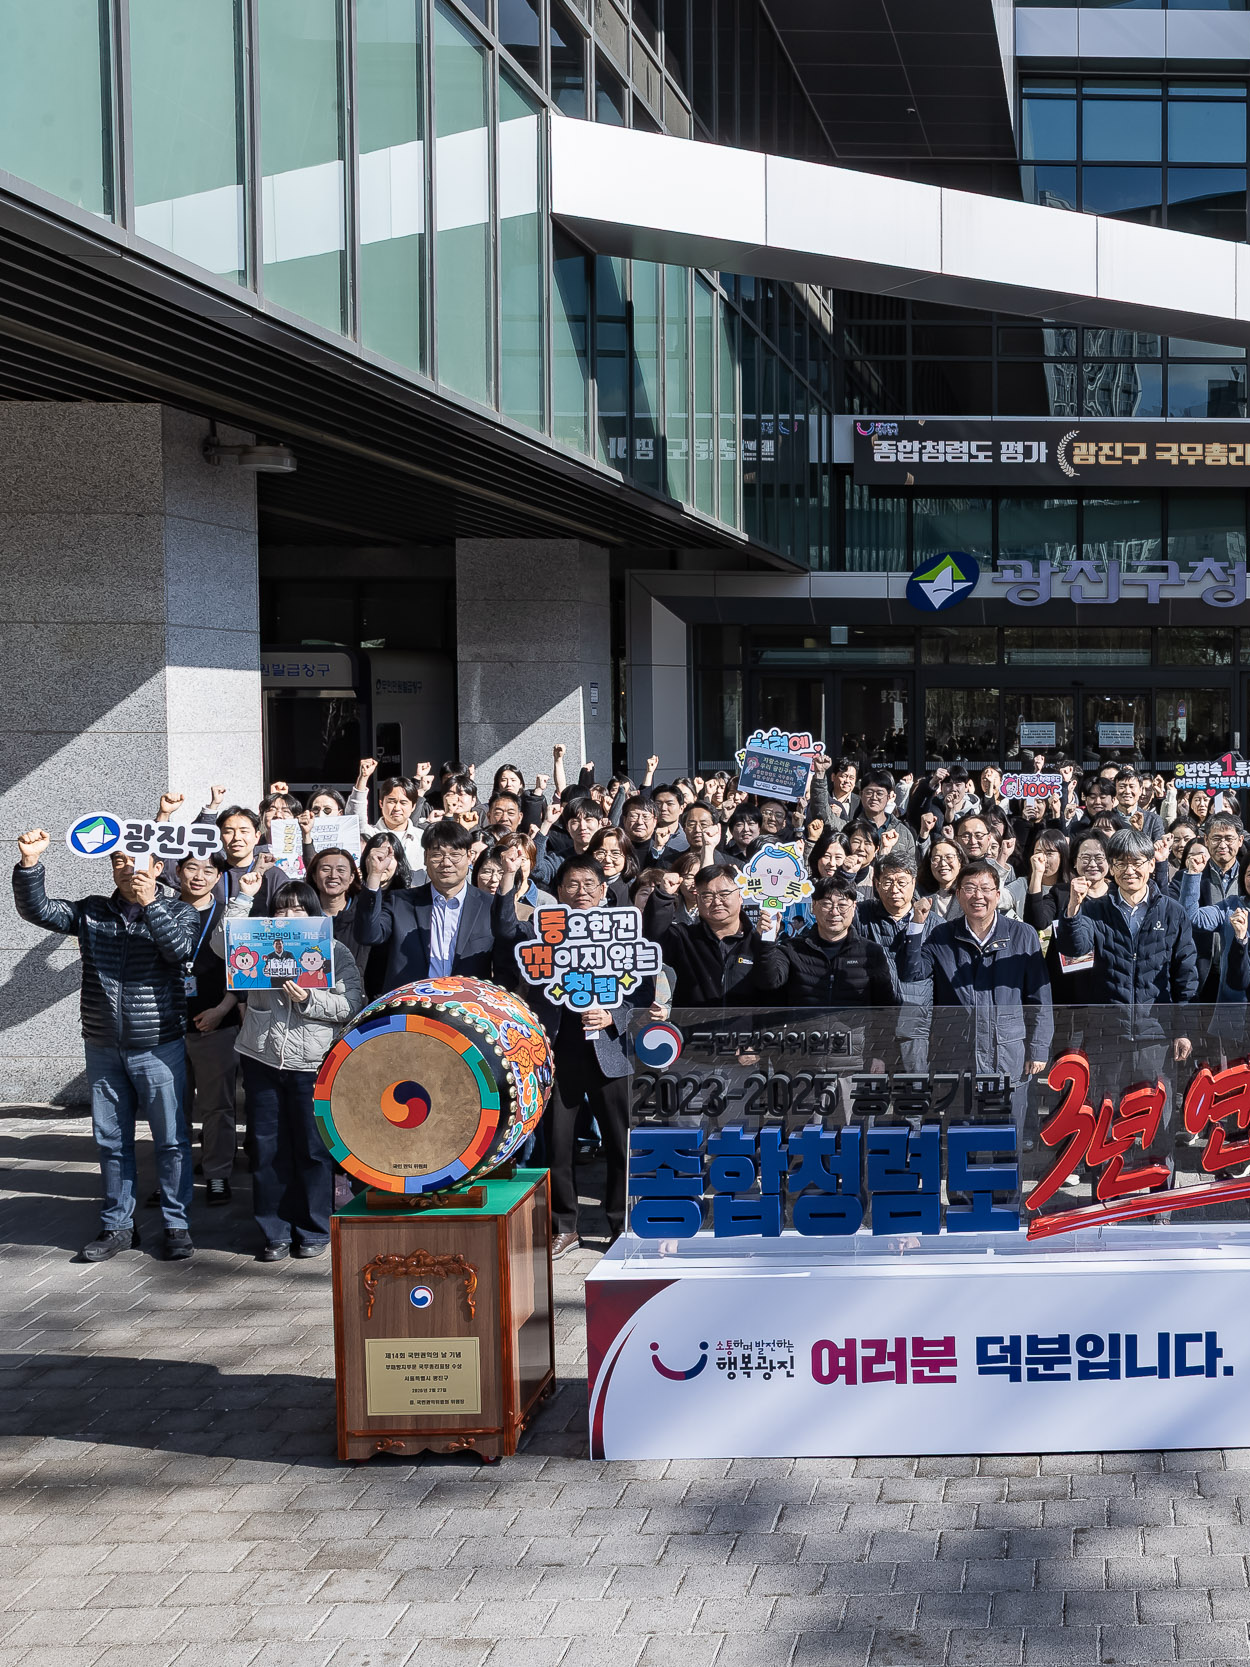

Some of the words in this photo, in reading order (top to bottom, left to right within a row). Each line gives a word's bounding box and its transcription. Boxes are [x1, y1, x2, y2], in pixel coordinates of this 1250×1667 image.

[873, 440, 993, 463] 종합청렴도
[1000, 441, 1049, 463] 평가
[1072, 442, 1147, 465] 광진구
[992, 557, 1247, 607] 광진구청
[1175, 777, 1207, 789] 여러분
[124, 824, 218, 855] 광진구
[252, 932, 291, 940] 국민권익의
[540, 911, 635, 943] 중요한건
[521, 946, 603, 977] 꺾이지
[610, 944, 655, 970] 않는
[564, 972, 616, 1006] 청렴
[691, 1030, 853, 1057] 국민권익위원회
[631, 1072, 839, 1117] 2023-2025
[850, 1073, 1016, 1116] 공공기관
[629, 1125, 1020, 1238] 종합청렴도
[1025, 1049, 1171, 1210] 3년
[715, 1338, 753, 1356] 소통하며
[755, 1338, 794, 1354] 발전하는
[811, 1335, 958, 1386] 여러분
[976, 1331, 1233, 1383] 덕분입니다.
[715, 1355, 795, 1379] 행복광진
